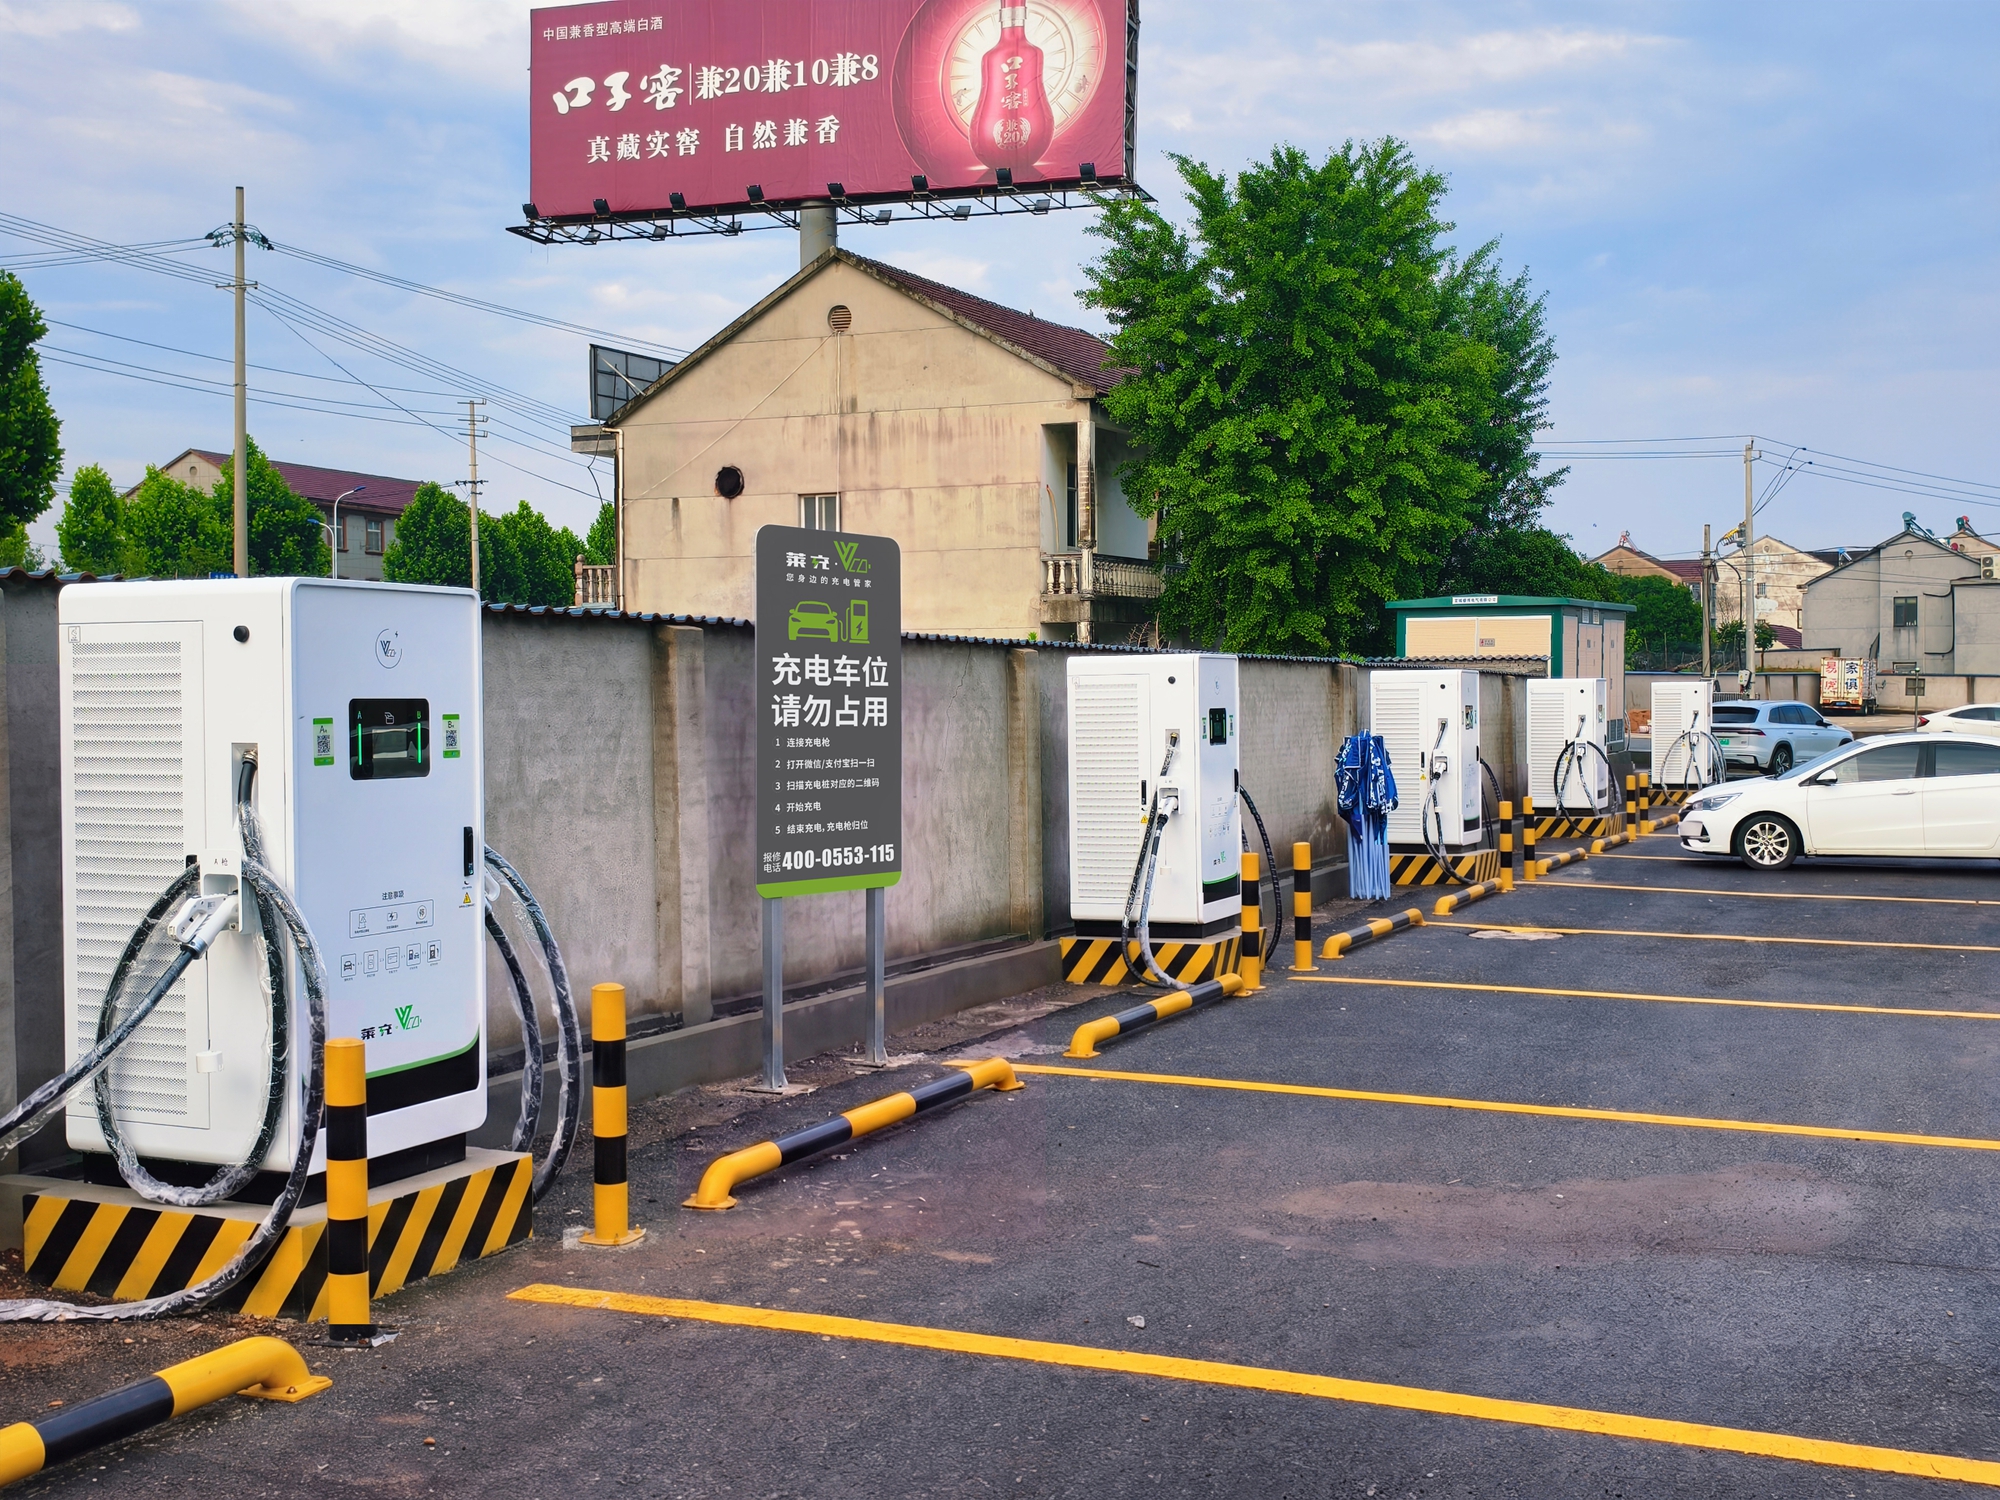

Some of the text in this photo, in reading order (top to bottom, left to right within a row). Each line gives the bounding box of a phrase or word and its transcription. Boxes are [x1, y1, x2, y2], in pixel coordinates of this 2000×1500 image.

[543, 16, 664, 42] 中国兼香型高端白酒
[552, 52, 879, 114] 口子窖 兼20兼10兼8
[587, 114, 841, 164] 真藏实窖 自然兼香
[786, 573, 872, 588] 您身边的充电管家
[772, 652, 889, 688] 充电车位
[771, 693, 888, 727] 请勿占用
[775, 737, 831, 748] 1 连接充电枪
[775, 758, 875, 770] 2 打开微信/支付宝扫一扫
[775, 778, 880, 791] 3 扫描充电桩对应的二维码
[775, 801, 822, 813] 4 开始充电
[775, 826, 781, 834] 5
[763, 843, 895, 870] 报修 400-0553-115
[763, 862, 781, 873] 电话
